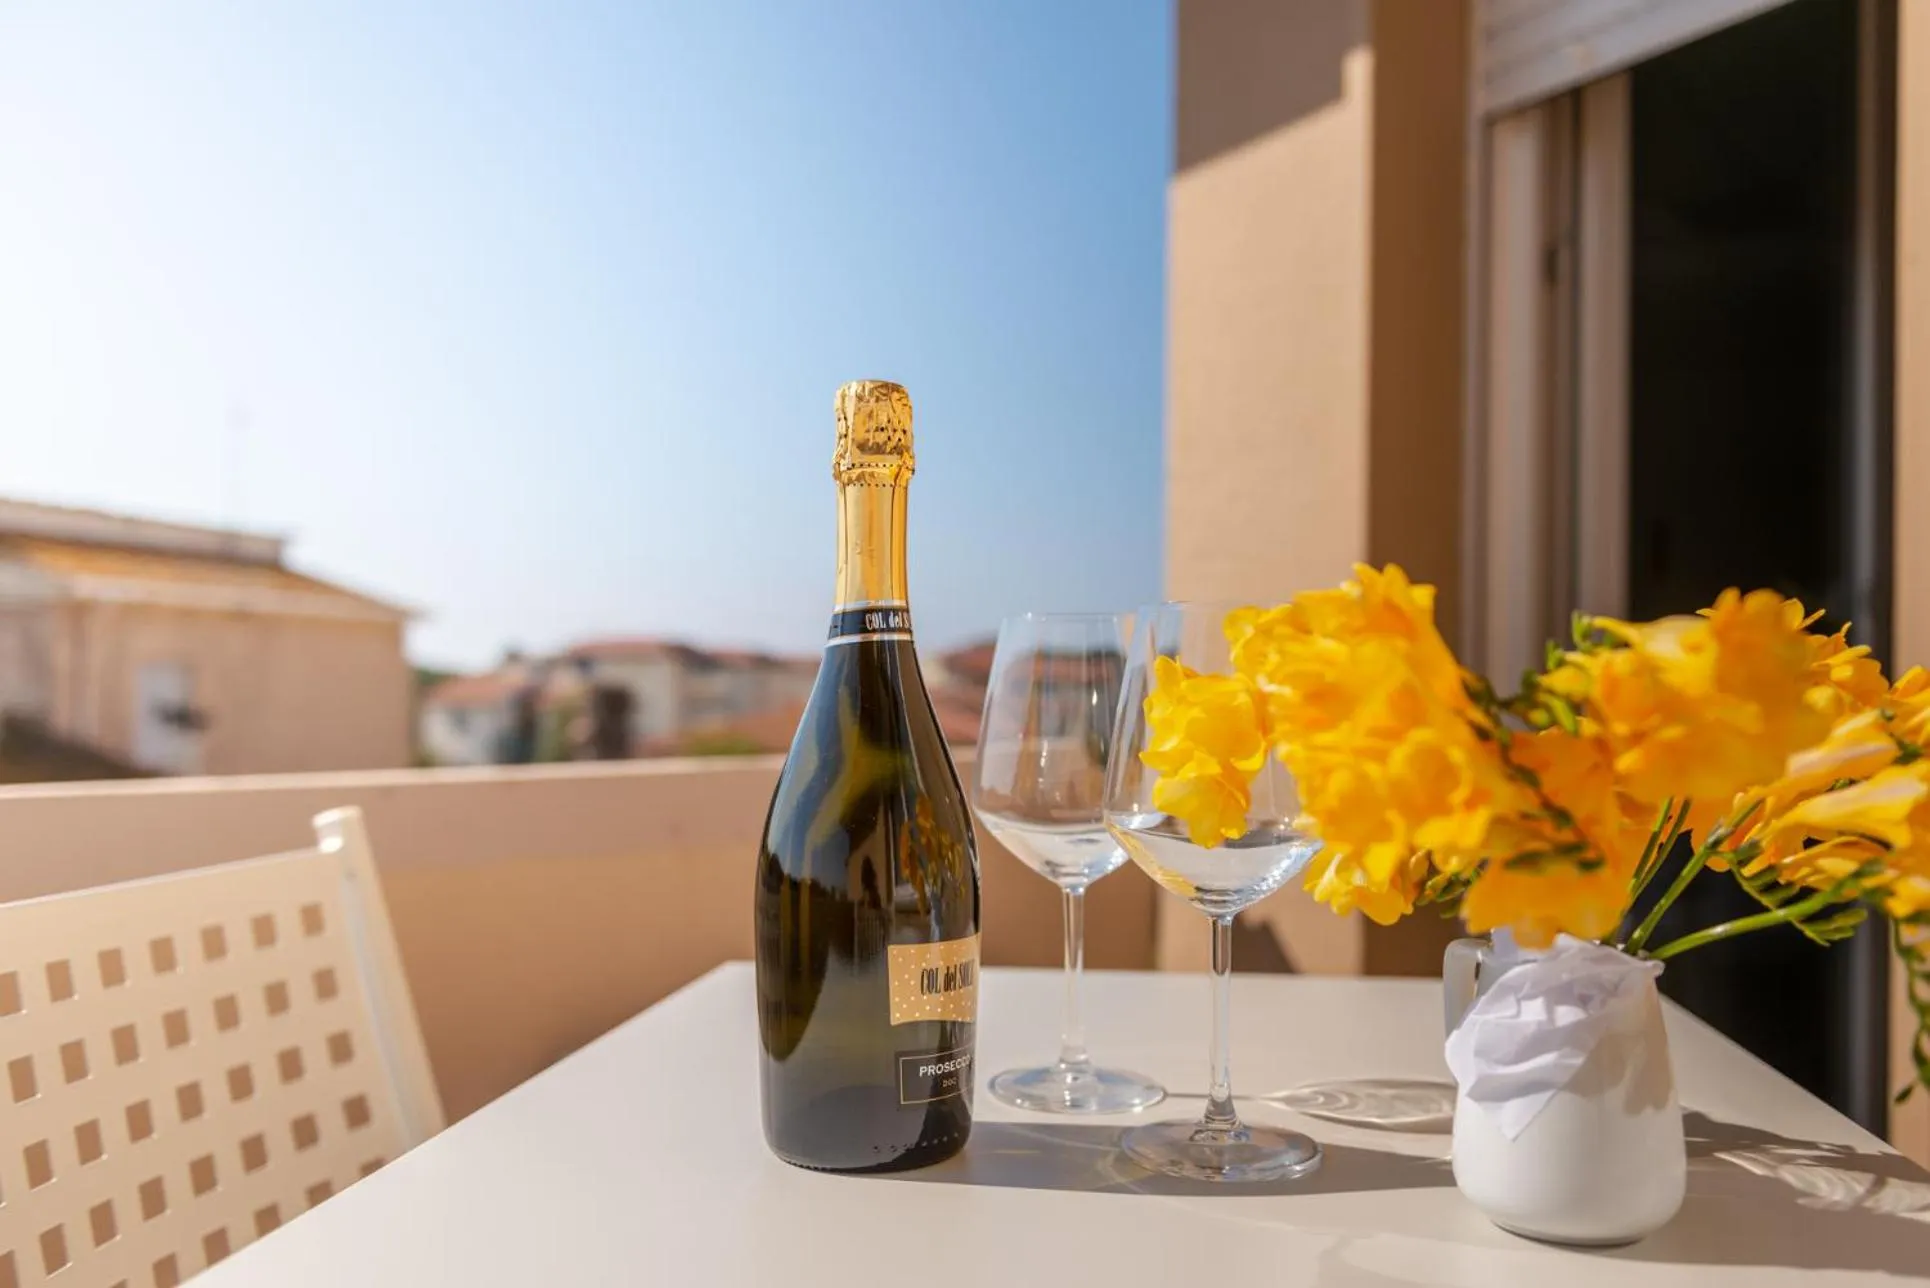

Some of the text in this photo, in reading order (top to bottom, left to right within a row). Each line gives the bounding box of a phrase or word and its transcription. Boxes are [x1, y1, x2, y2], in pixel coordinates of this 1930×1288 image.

[865, 611, 887, 630] COL
[888, 610, 903, 629] del
[920, 967, 941, 996] COL
[943, 963, 957, 992] del
[919, 1054, 971, 1077] PROSECCO
